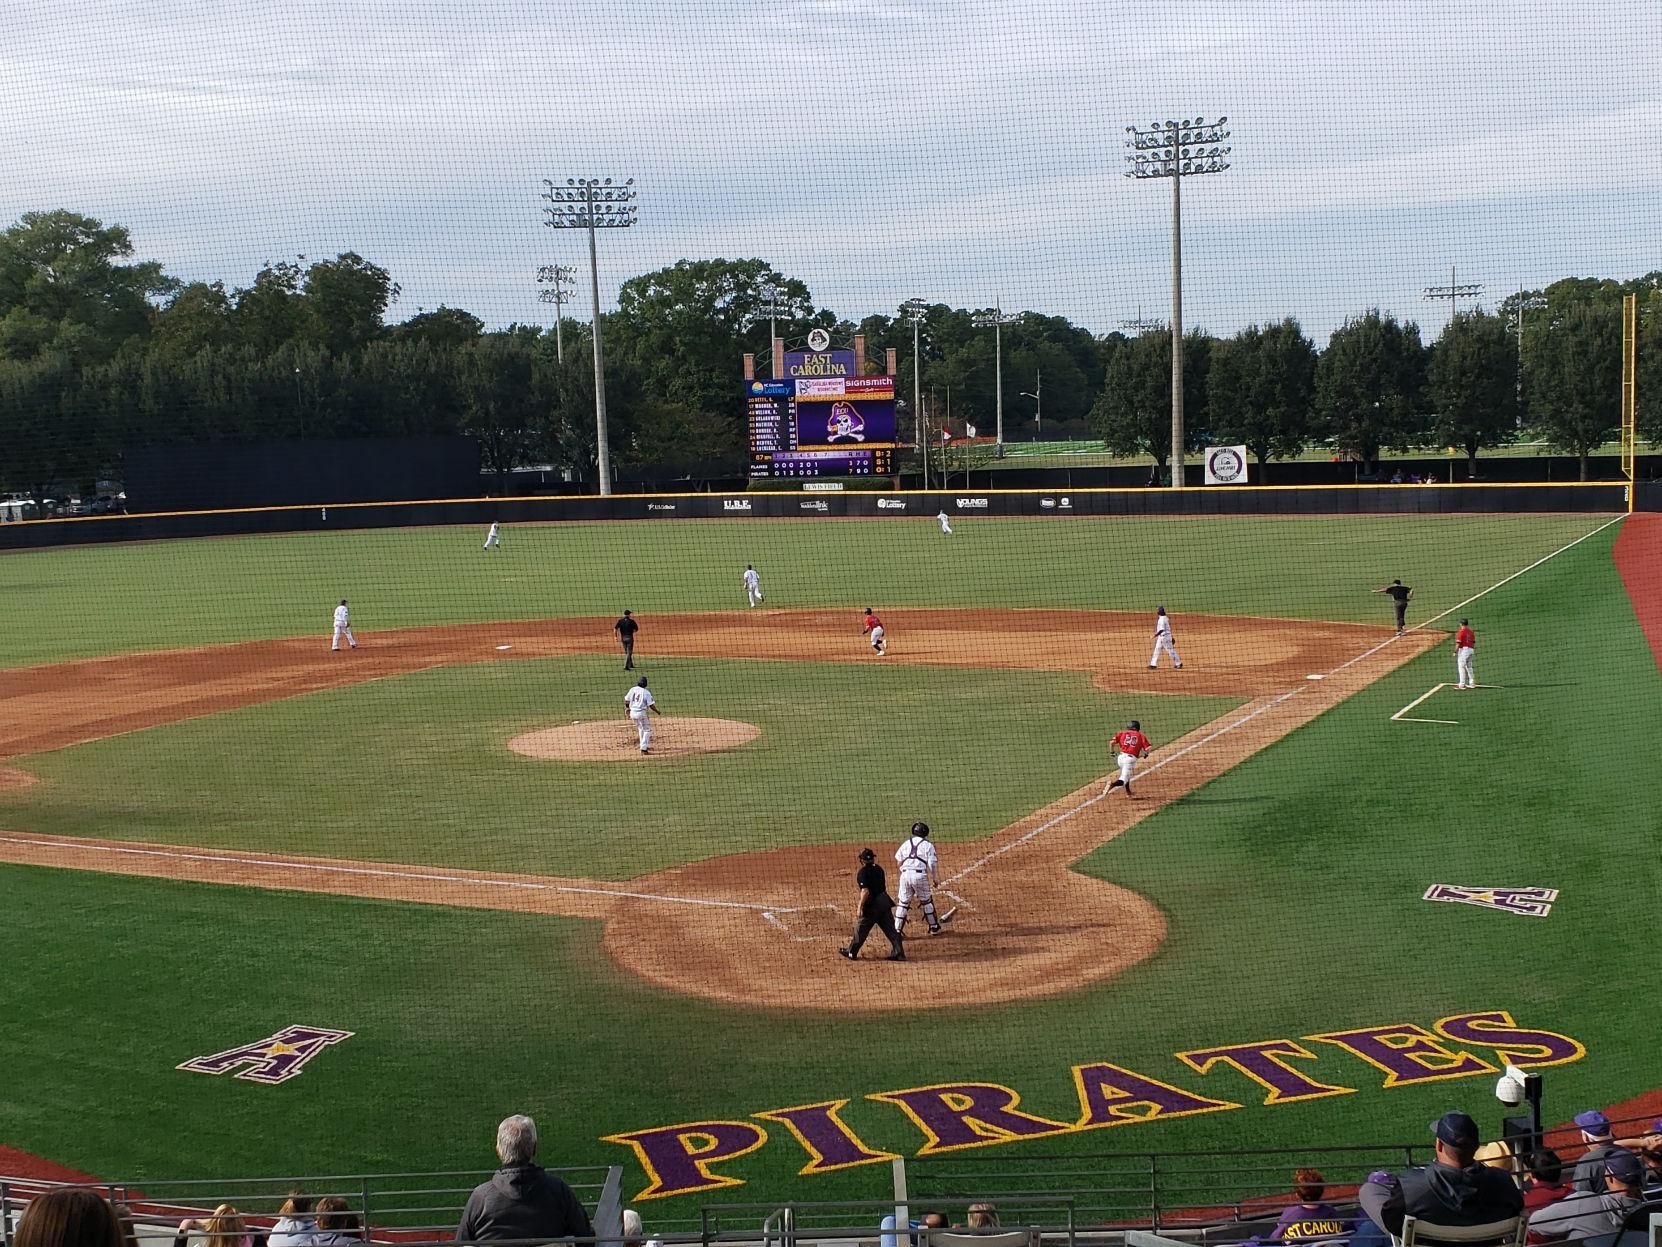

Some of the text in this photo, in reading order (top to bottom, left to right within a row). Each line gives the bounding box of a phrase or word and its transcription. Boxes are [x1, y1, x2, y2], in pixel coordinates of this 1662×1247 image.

[804, 354, 832, 365] EAST
[790, 363, 846, 376] CAROLINA
[764, 386, 791, 394] Lottery
[599, 1011, 1586, 1201] PIRATES
